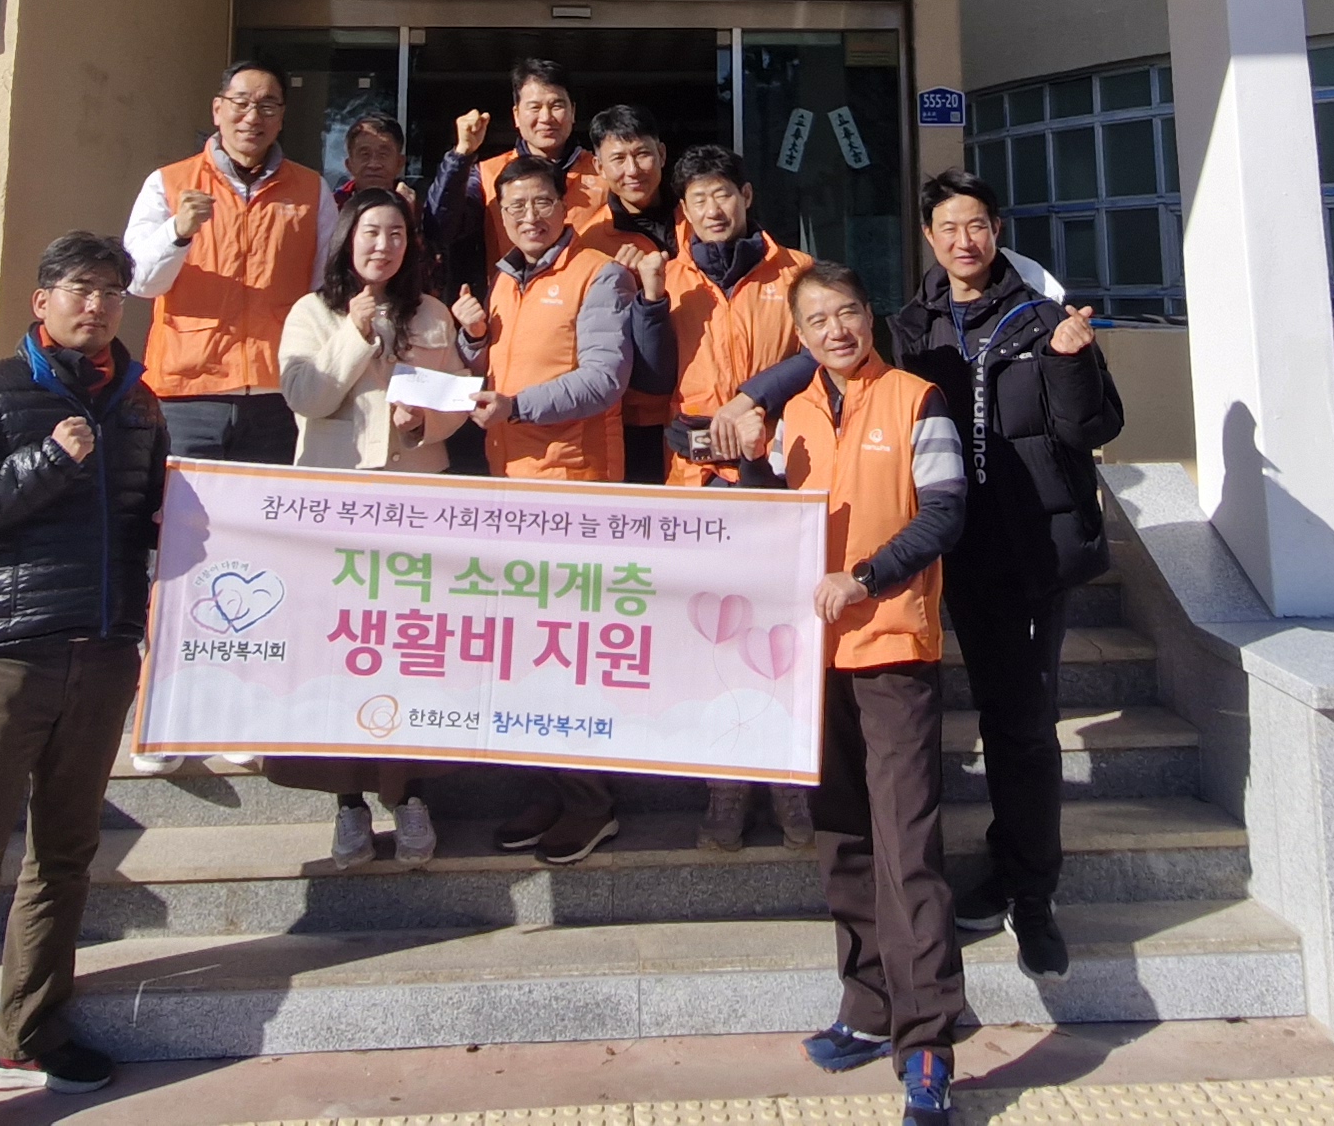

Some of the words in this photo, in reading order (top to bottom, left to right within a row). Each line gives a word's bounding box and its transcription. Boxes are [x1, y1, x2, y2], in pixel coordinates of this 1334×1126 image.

[923, 94, 959, 108] 555-20
[261, 495, 331, 523] 참사랑
[336, 500, 428, 529] 복지회는
[433, 505, 572, 537] 사회적약자와
[578, 513, 601, 538] 늘
[607, 514, 652, 540] 함께
[658, 516, 731, 543] 합니다.
[332, 547, 432, 603] 지역
[448, 557, 657, 617] 소외계층
[181, 639, 286, 662] 참사랑복지회
[326, 608, 514, 681] 생활비
[532, 620, 652, 690] 지원
[408, 708, 481, 731] 한화오션
[492, 711, 614, 740] 참사랑복지회
